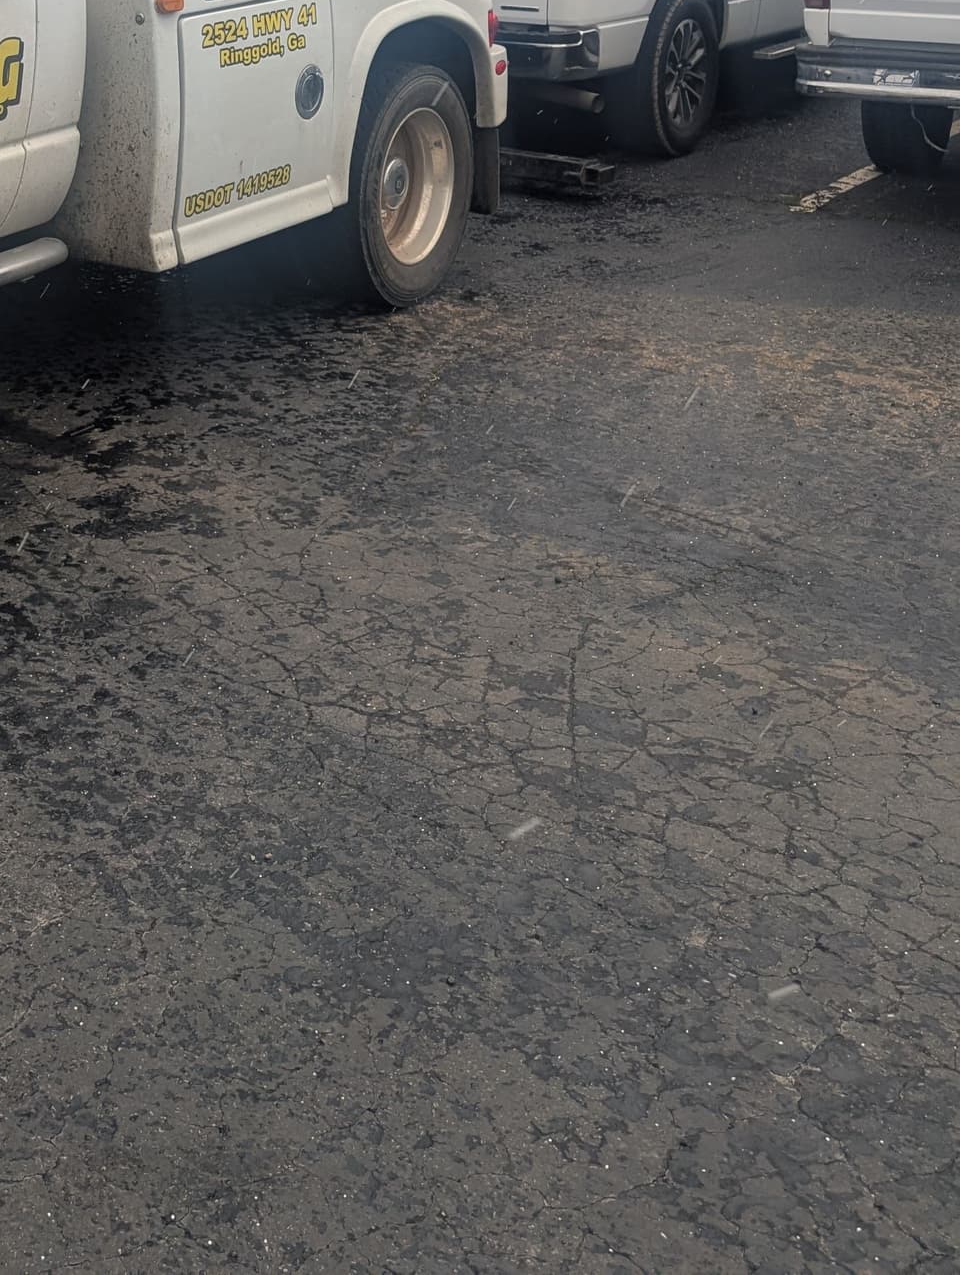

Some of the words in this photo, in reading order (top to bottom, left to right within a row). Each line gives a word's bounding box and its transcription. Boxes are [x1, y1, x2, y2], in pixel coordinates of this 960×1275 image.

[202, 17, 248, 48] 2524
[252, 8, 294, 37] HWY
[297, 2, 318, 28] 41
[219, 37, 285, 67] Ringgold,
[287, 33, 306, 51] Ga
[184, 183, 234, 218] USDOT
[236, 164, 292, 200] 1419528
